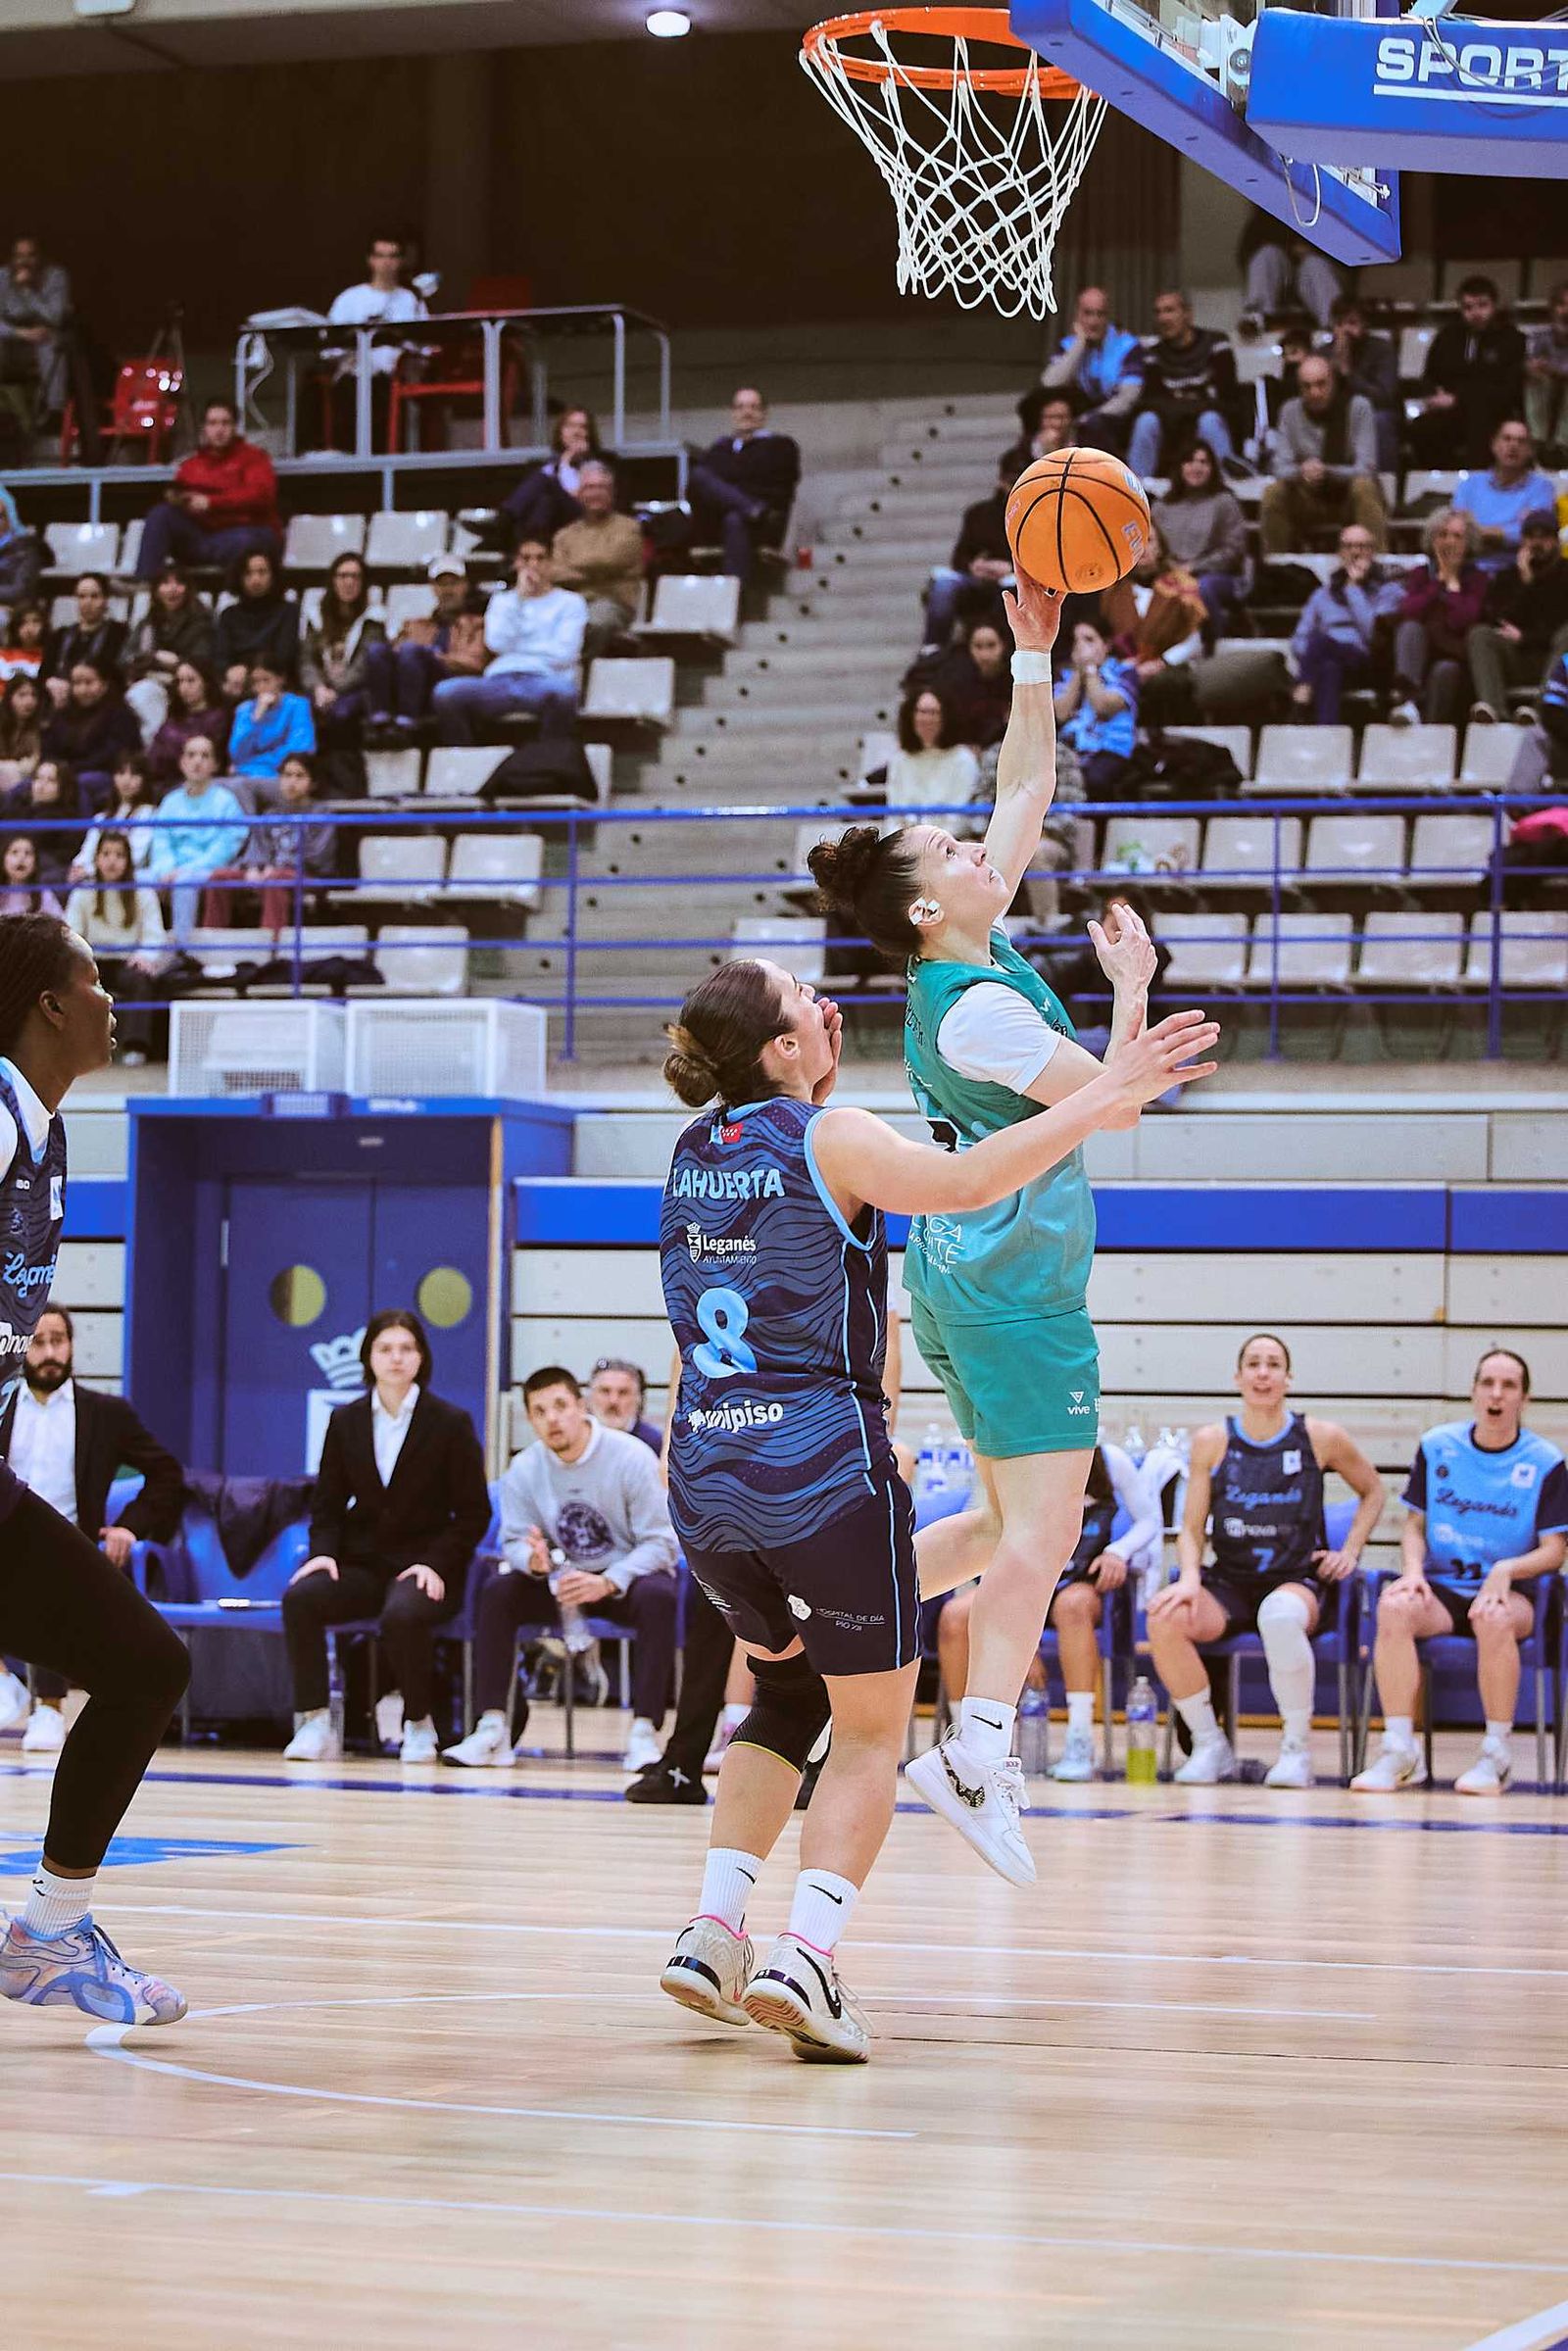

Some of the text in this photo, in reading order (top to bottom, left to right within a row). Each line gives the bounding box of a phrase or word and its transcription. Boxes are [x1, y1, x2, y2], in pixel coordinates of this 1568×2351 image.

[672, 1168, 785, 1200] LAHUERTA
[703, 1235, 757, 1255] Leganés
[693, 1287, 759, 1379] 8
[1251, 1548, 1274, 1573] 7
